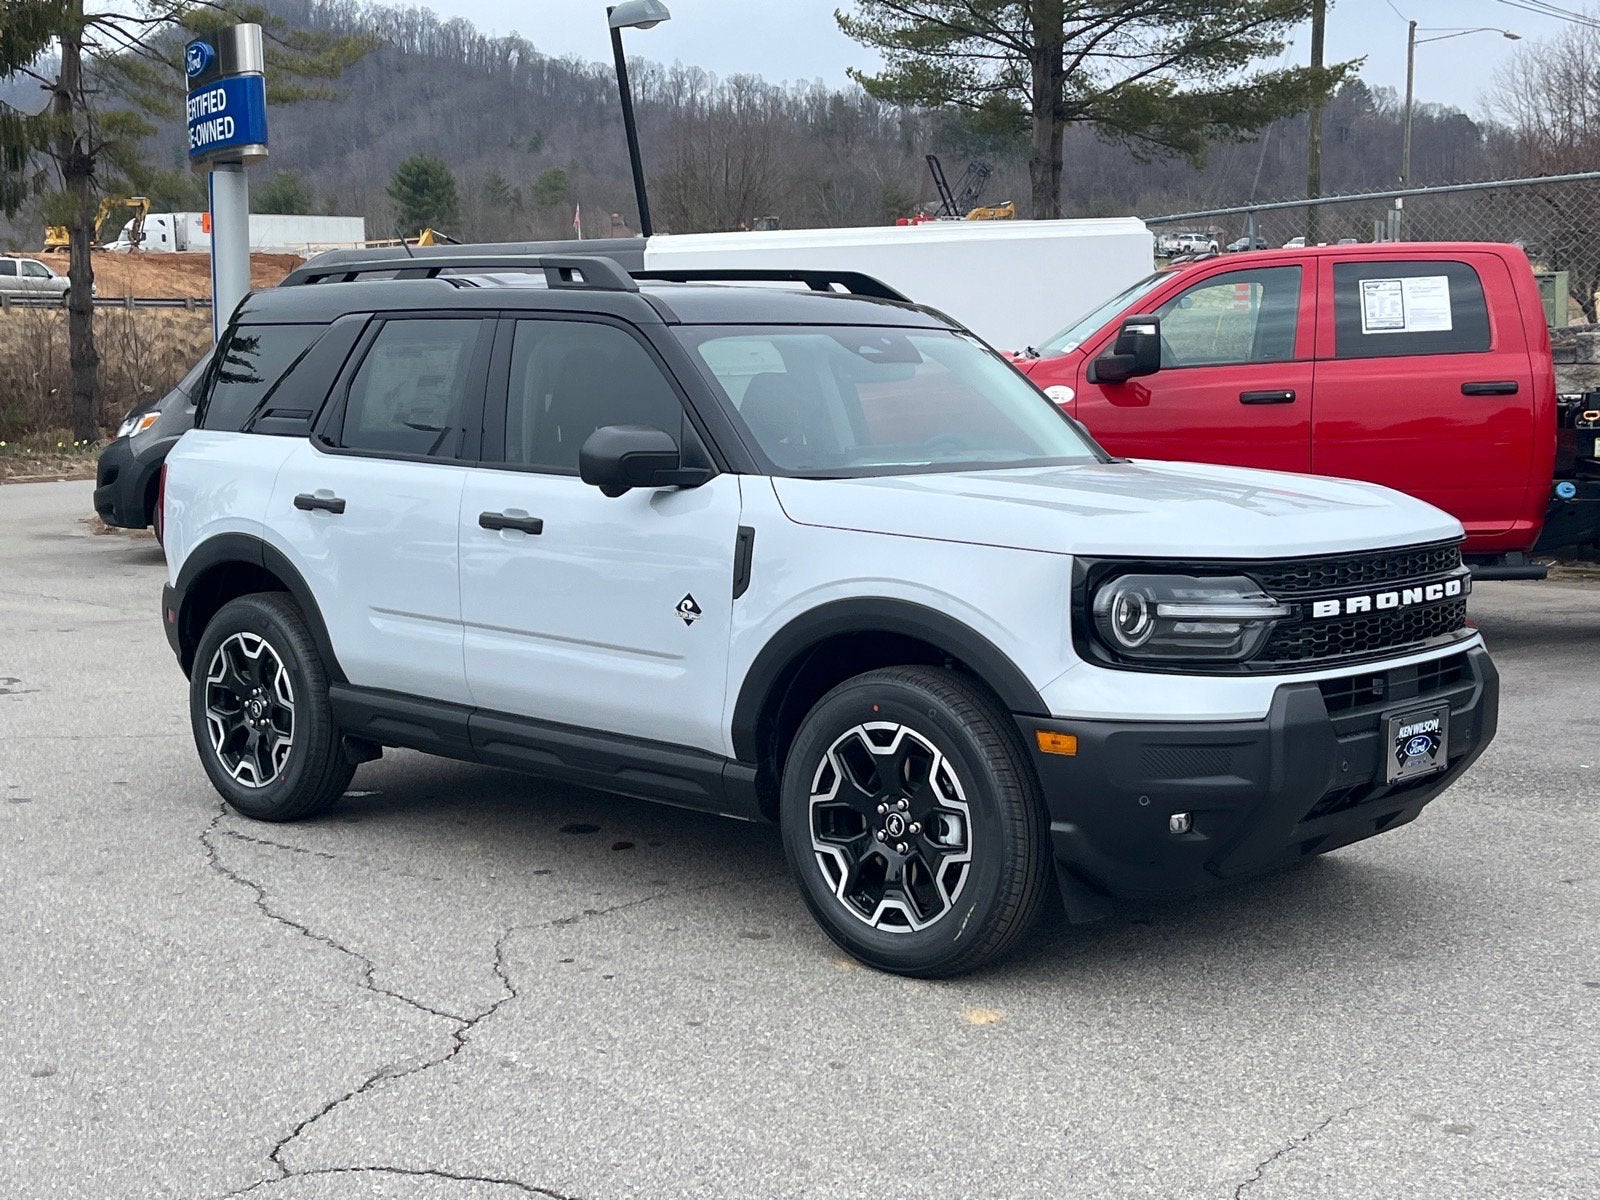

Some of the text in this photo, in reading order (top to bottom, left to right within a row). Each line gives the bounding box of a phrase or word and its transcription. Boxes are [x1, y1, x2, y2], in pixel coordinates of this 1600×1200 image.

[187, 49, 201, 72] Ford
[188, 88, 227, 121] ERTIFIED
[1313, 580, 1461, 618] BRONCO
[1399, 718, 1439, 738] KEN WILSON
[1409, 738, 1427, 755] Ford
